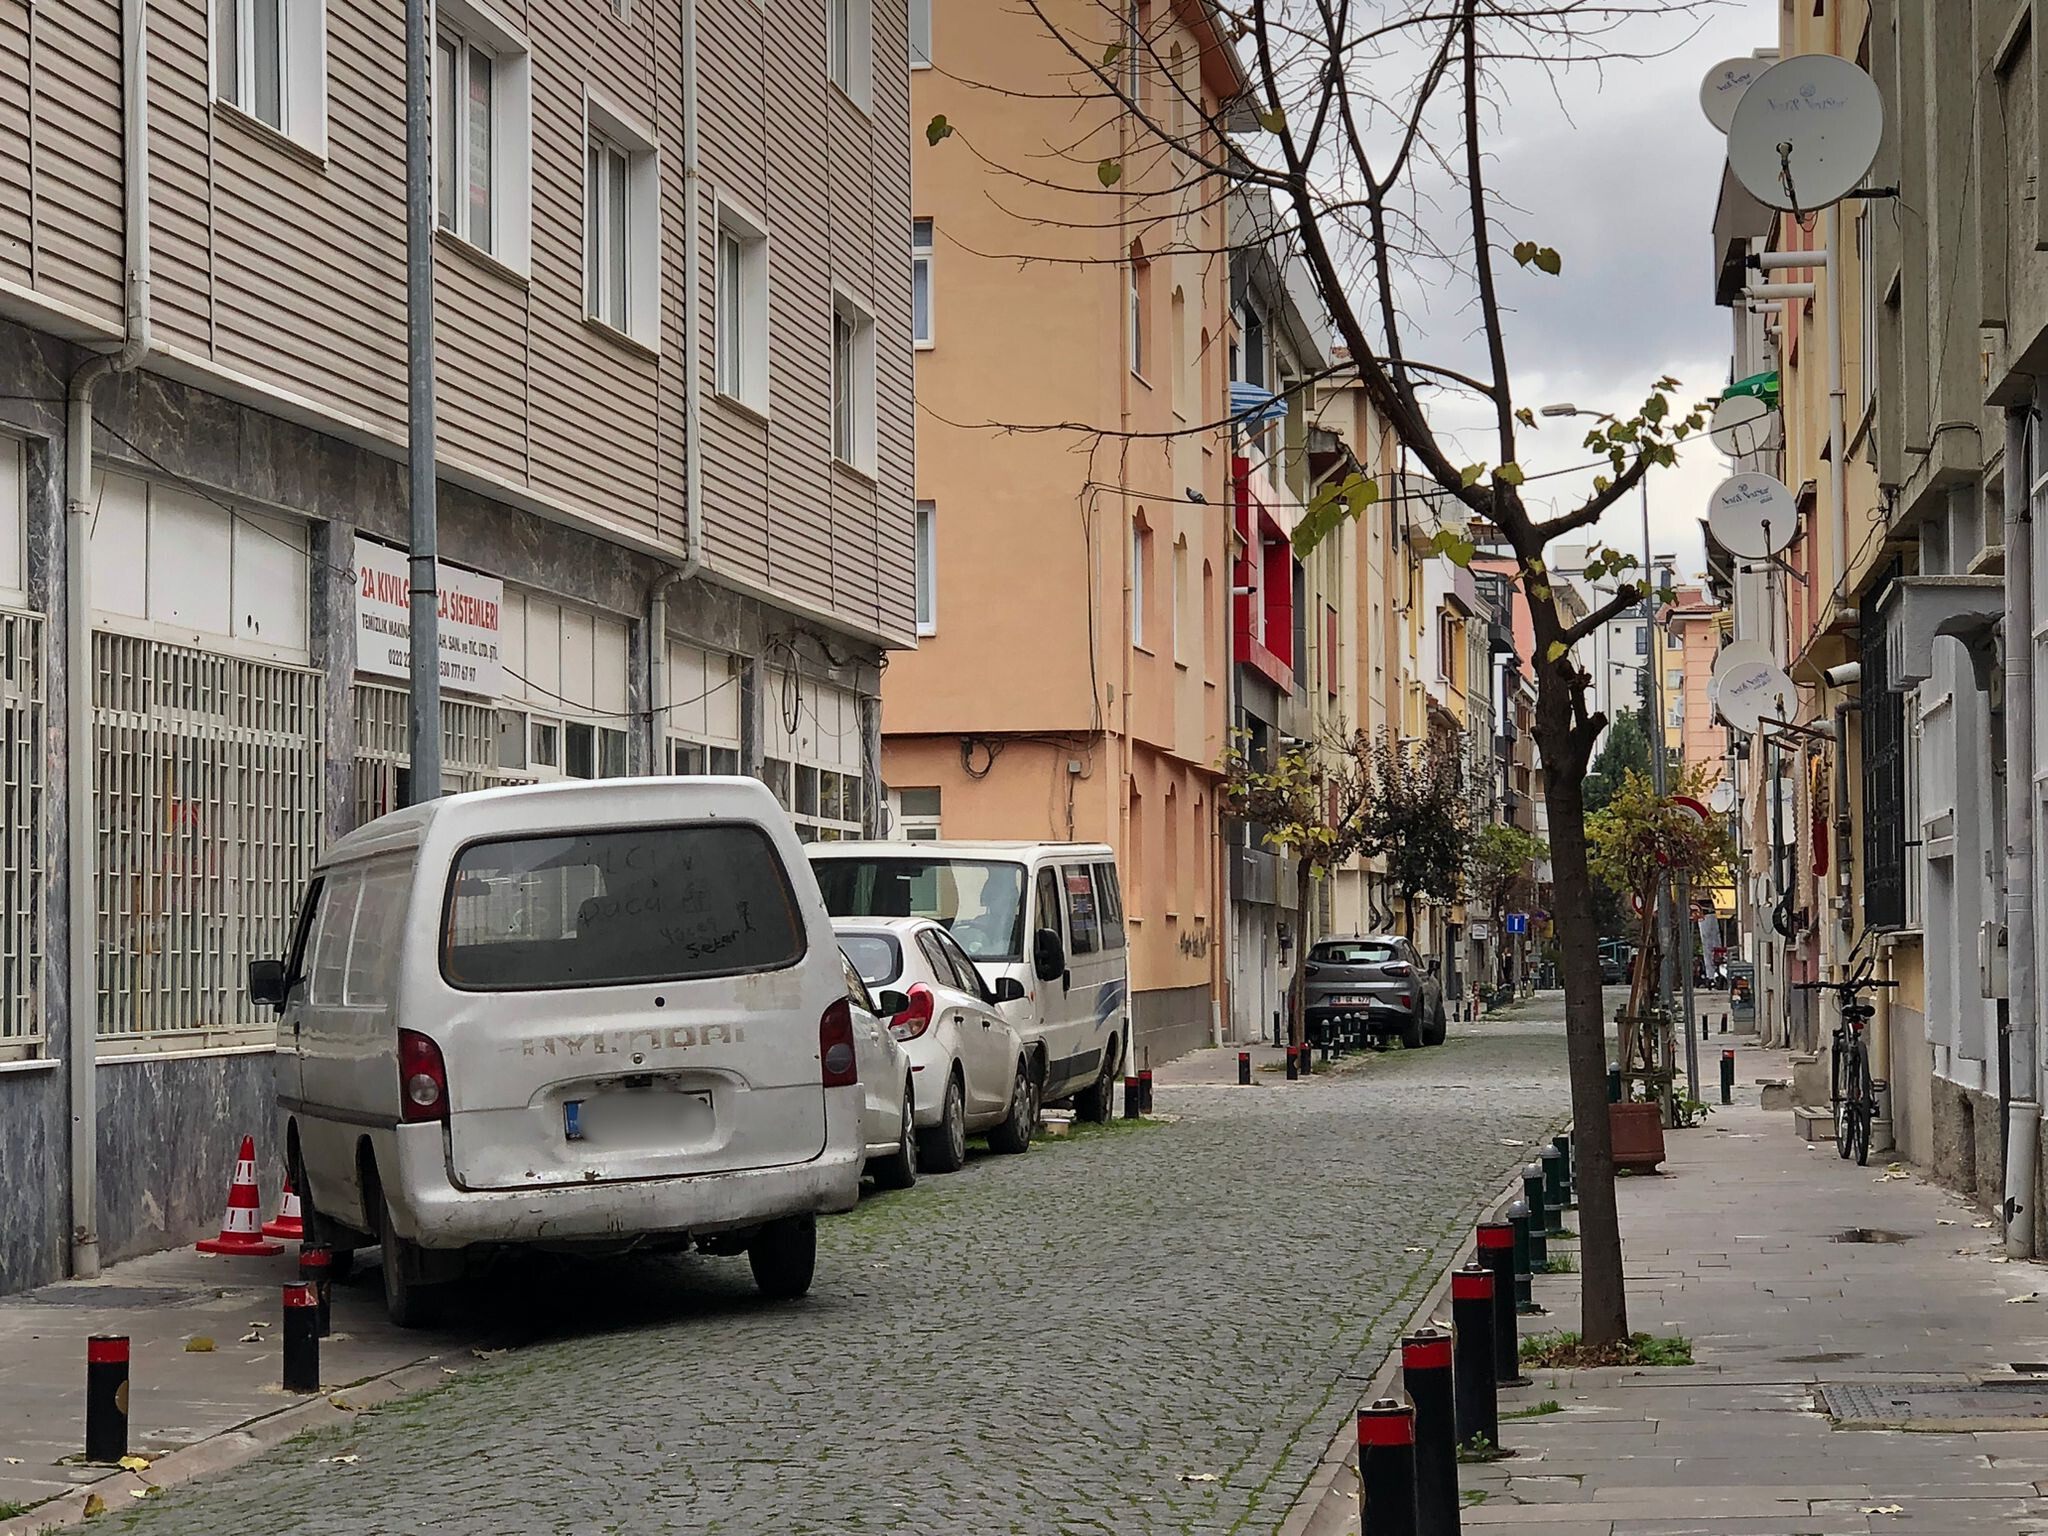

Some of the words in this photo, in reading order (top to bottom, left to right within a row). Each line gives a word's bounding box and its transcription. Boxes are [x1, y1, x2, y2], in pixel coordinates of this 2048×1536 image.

[361, 566, 375, 600] 2A
[378, 571, 410, 609] KIVILC
[451, 585, 498, 632] SİSTEMLERİ
[389, 618, 410, 640] MAKİN
[388, 648, 403, 667] 0222
[440, 660, 450, 679] 530
